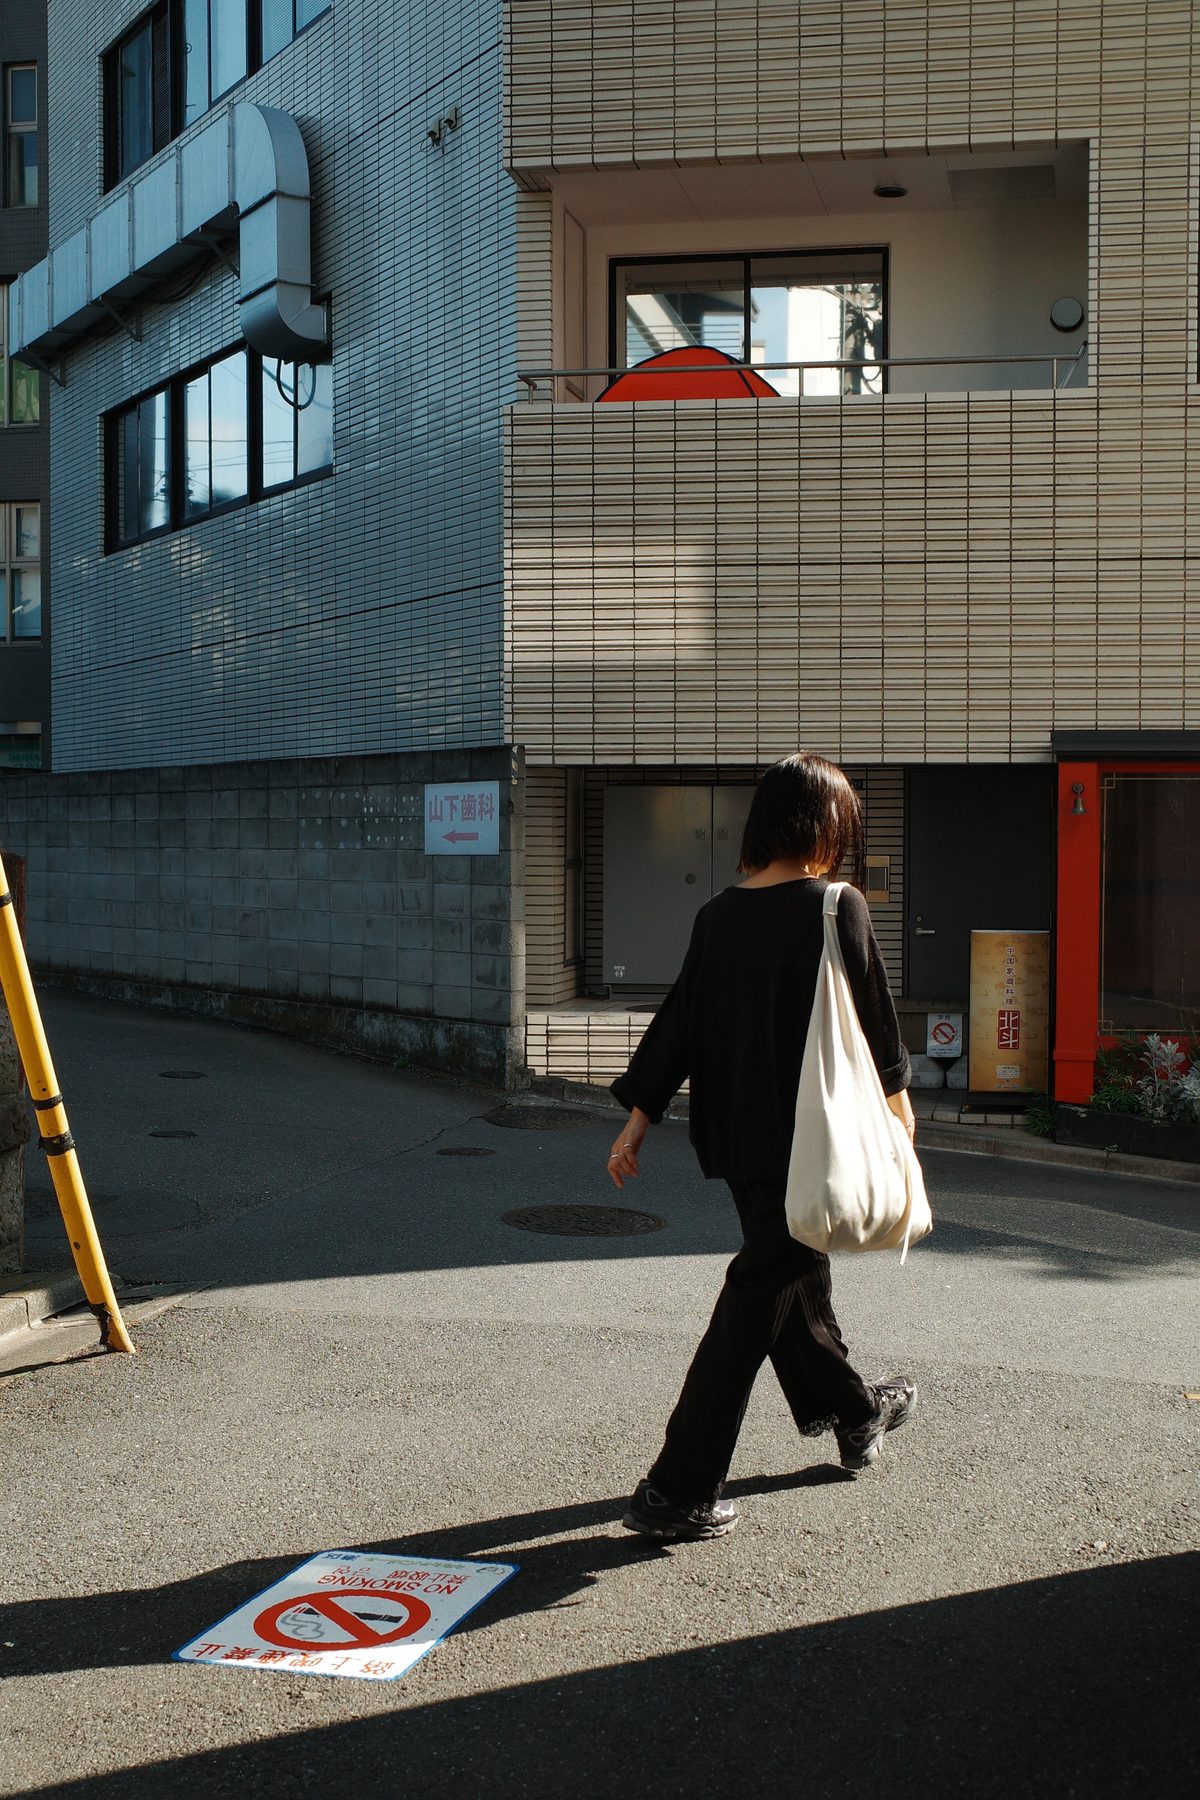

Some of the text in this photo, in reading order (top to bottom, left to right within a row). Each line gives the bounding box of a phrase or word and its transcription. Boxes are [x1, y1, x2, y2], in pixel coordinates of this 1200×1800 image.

[429, 793, 494, 822] 山下歯科
[1005, 947, 1015, 1005] 中国家庭料理
[998, 1011, 1019, 1049] 北斗
[317, 1574, 460, 1595] NO SMOKING
[192, 1642, 396, 1675] 路上喫煙禁止
